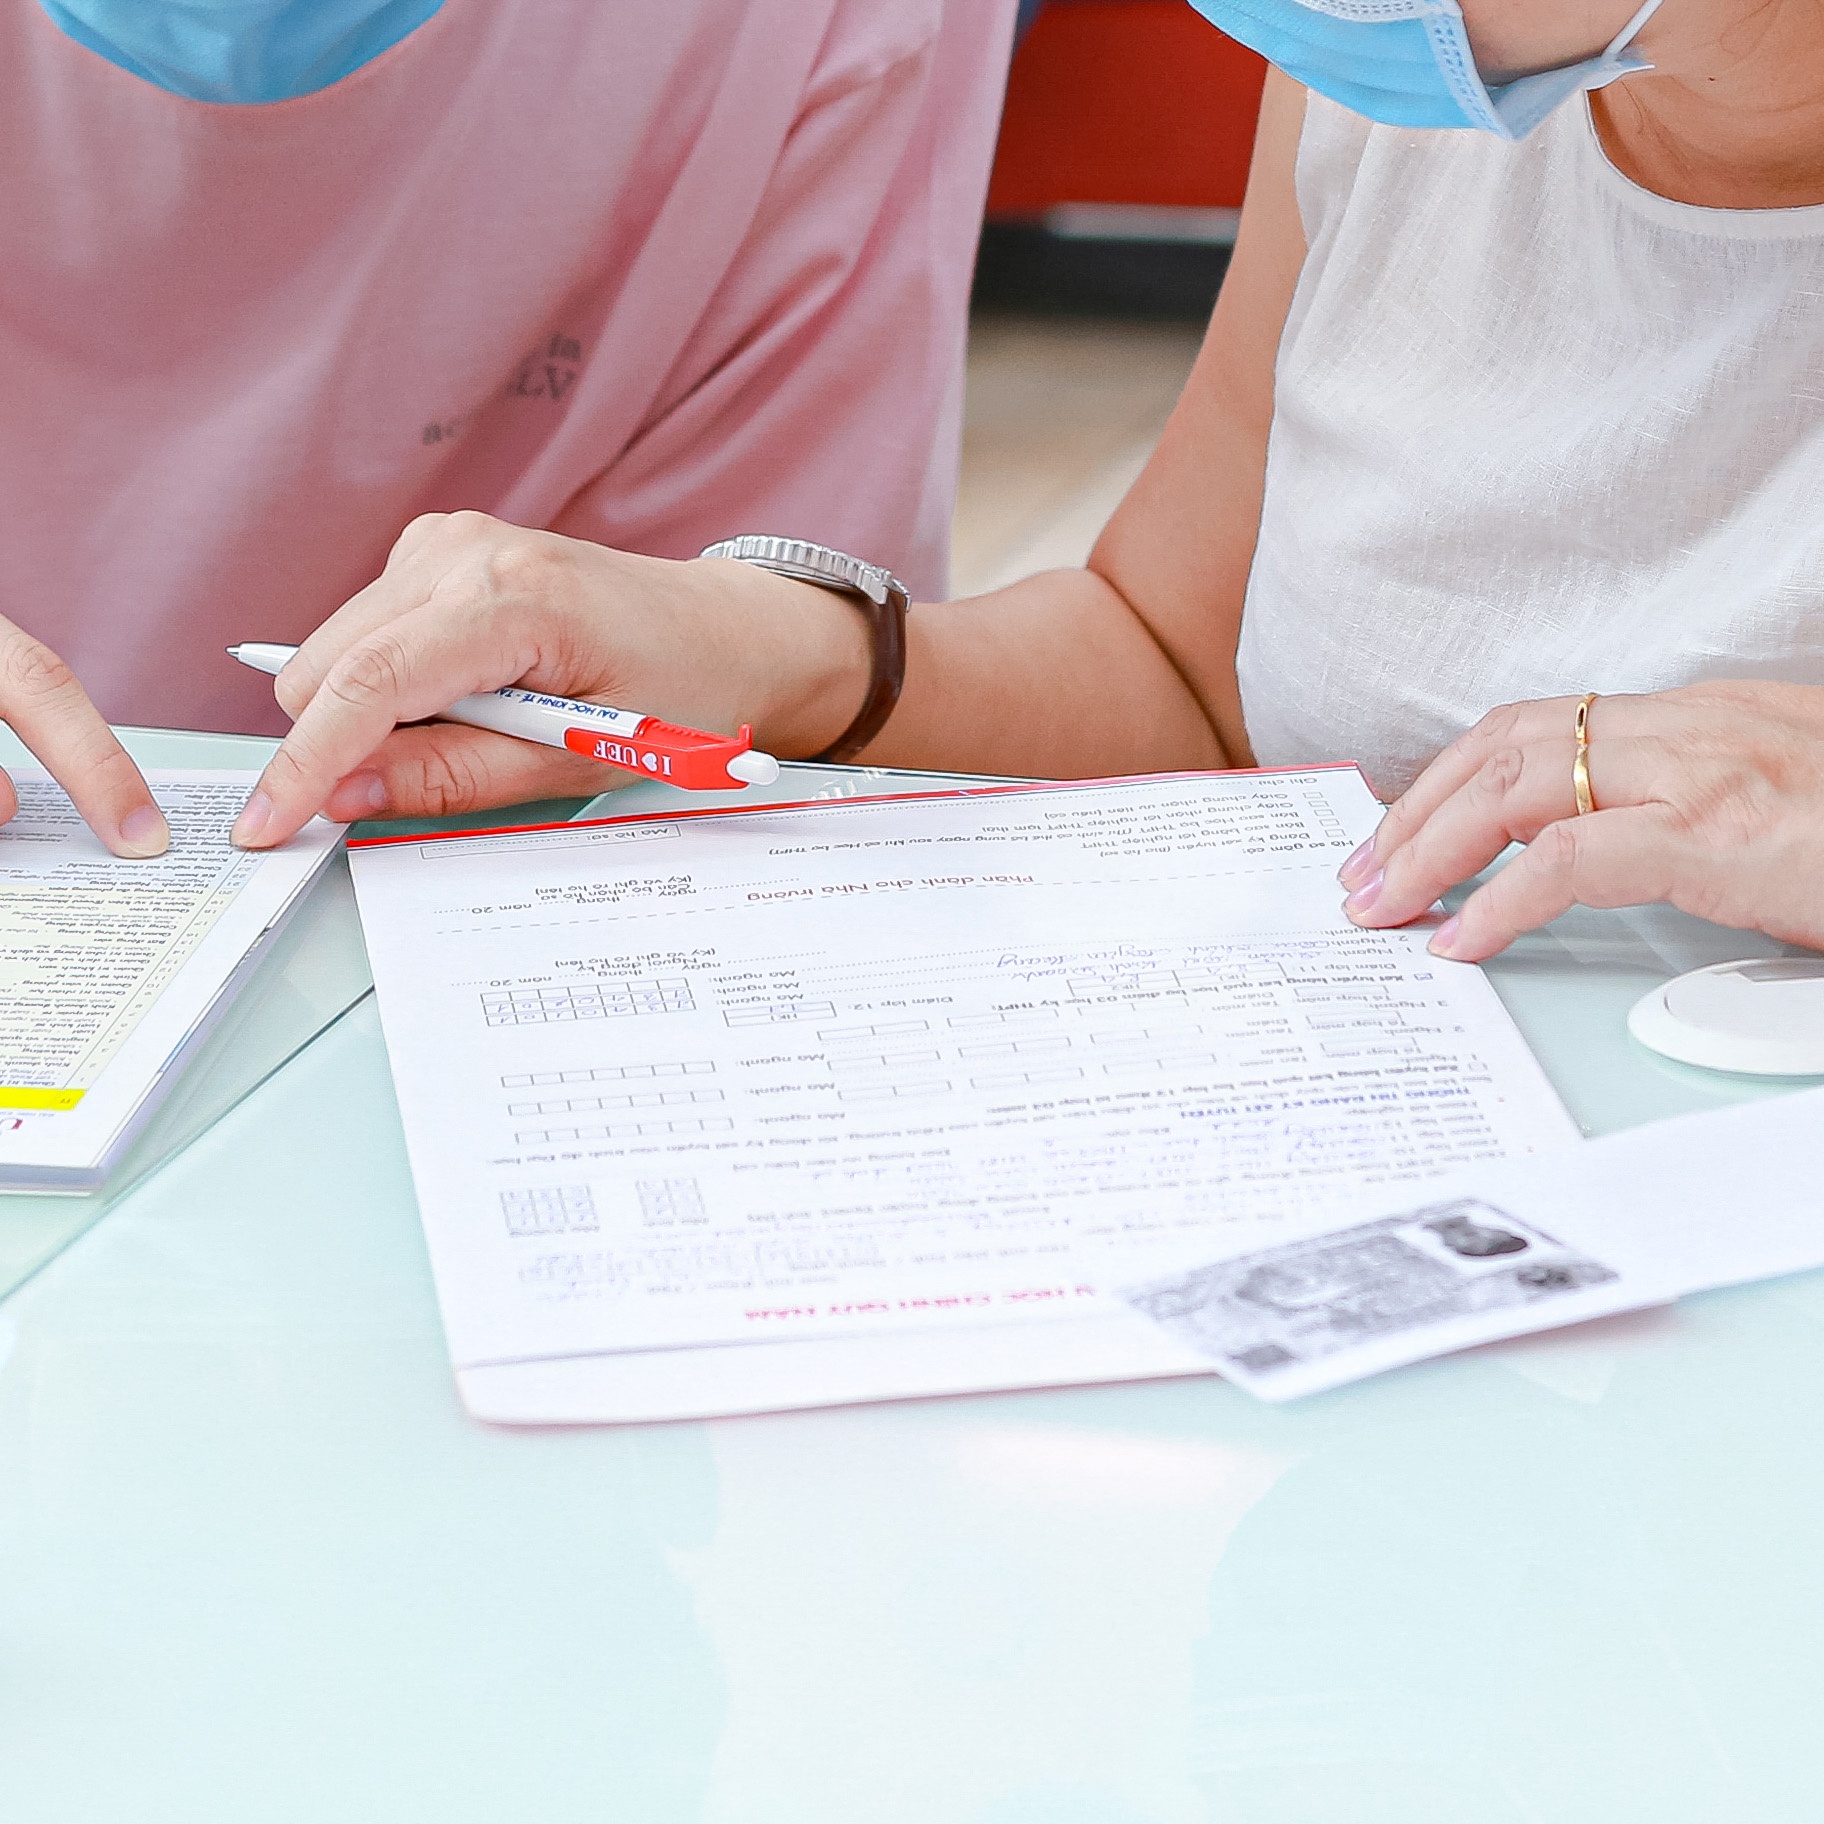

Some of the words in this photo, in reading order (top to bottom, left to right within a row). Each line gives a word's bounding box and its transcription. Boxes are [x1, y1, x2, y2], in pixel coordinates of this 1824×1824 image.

[519, 693, 537, 706] TẾ
[537, 696, 568, 710] KINH
[569, 702, 594, 716] HỌC
[593, 739, 639, 768] UEF
[662, 755, 672, 776] I
[1047, 822, 1084, 831] THPT
[1139, 824, 1176, 834] THPT
[1080, 840, 1119, 849] THPT
[614, 879, 638, 888] ghi
[920, 877, 974, 886] dành
[981, 875, 1034, 883] Phần
[821, 883, 869, 894] Nhà
[875, 880, 914, 888] cho
[658, 888, 697, 897] ngày
[747, 888, 814, 901] trường
[576, 896, 621, 904] tháng
[471, 906, 494, 914] 20
[636, 952, 661, 961] ghi
[681, 962, 721, 971] ngày
[597, 969, 643, 977] tháng
[489, 979, 512, 987] 20
